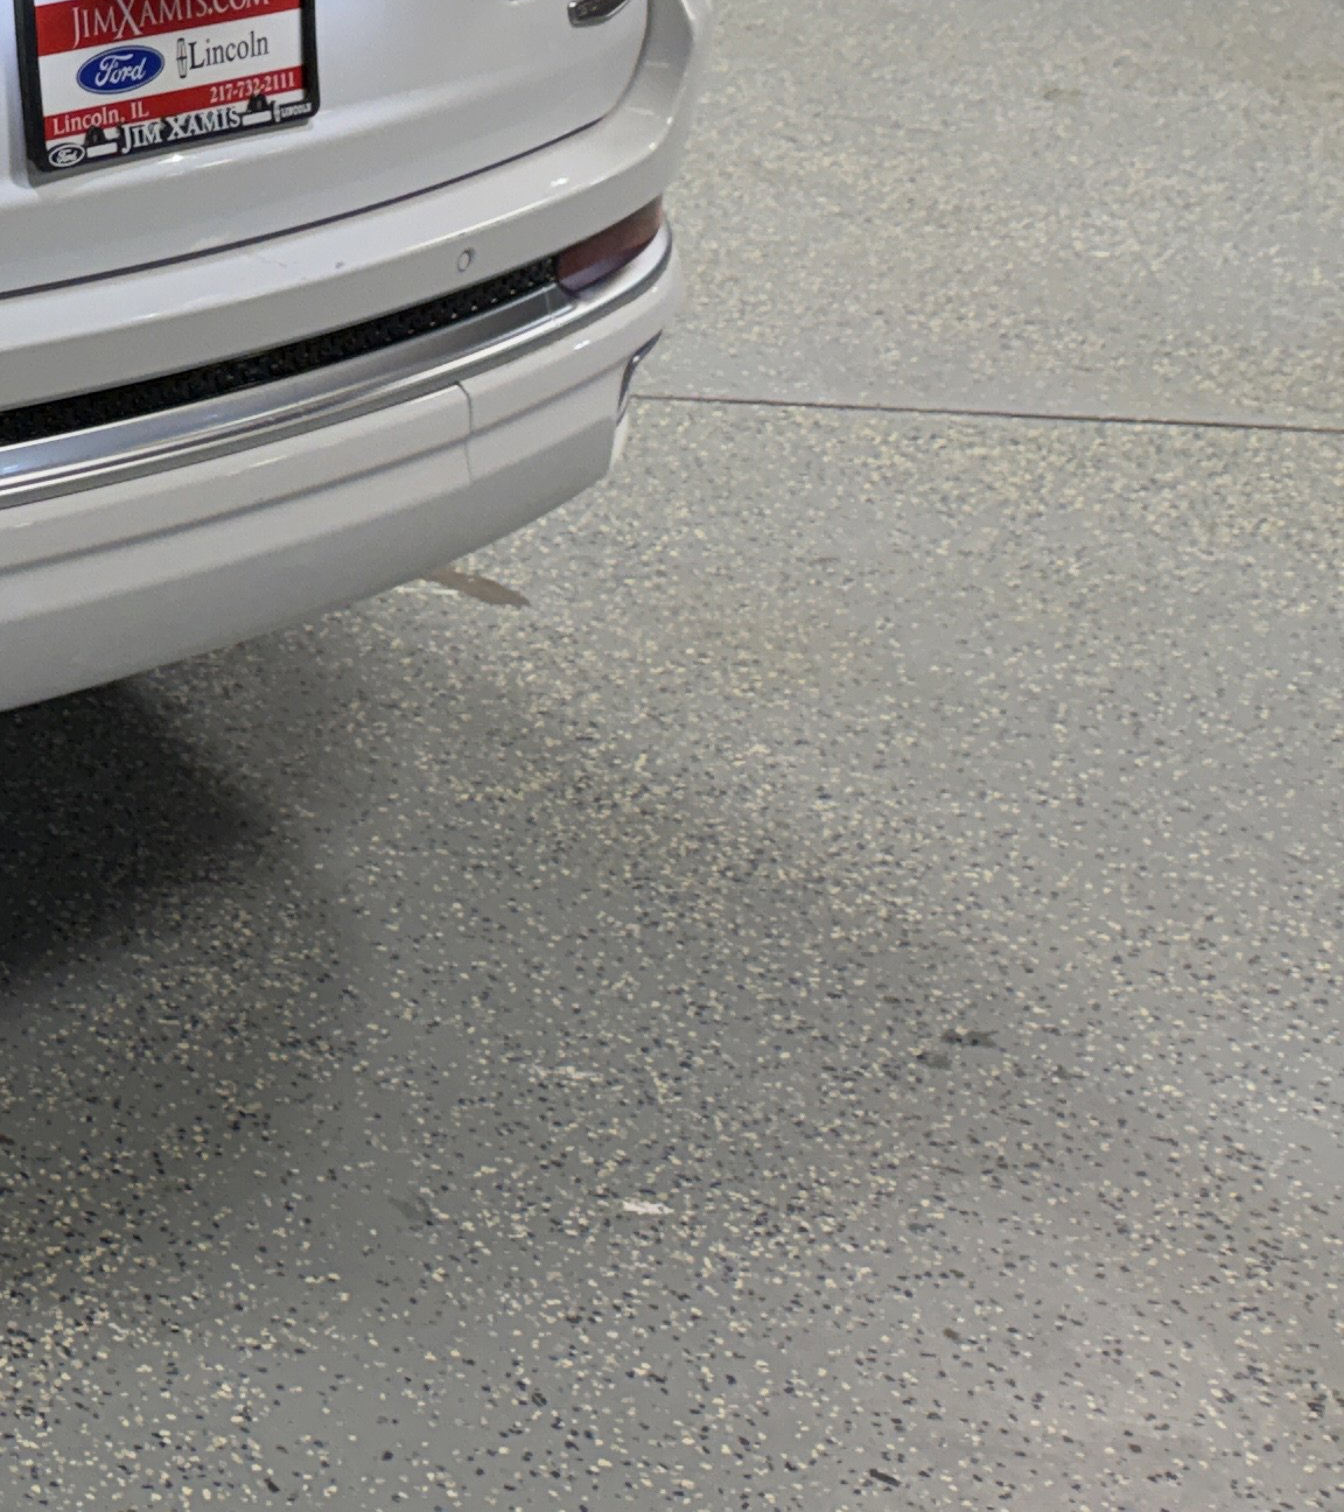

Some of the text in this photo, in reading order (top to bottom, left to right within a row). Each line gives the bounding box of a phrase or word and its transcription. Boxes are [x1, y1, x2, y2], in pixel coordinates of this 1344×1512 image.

[188, 31, 270, 71] Lincoln
[95, 53, 147, 87] Ford
[209, 71, 296, 104] 217-732-2111
[131, 101, 149, 120] IL
[121, 108, 241, 154] JIM XAMIS
